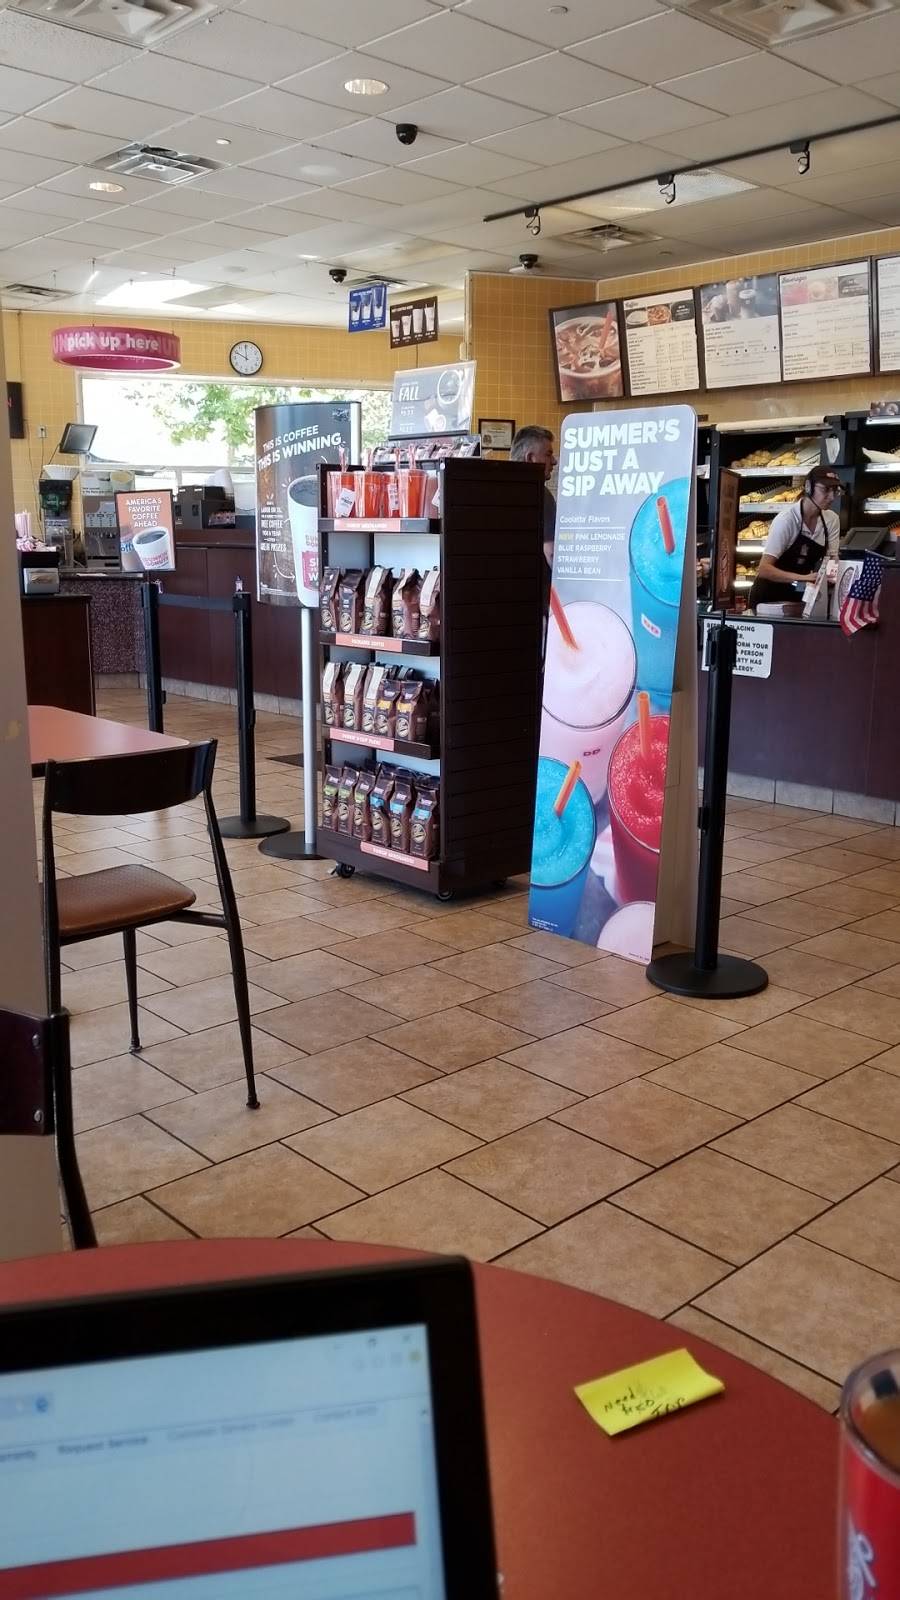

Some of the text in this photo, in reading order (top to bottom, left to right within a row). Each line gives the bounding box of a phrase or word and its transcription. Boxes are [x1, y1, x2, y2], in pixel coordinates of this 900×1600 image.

[67, 332, 96, 352] pick
[100, 336, 121, 351] up
[126, 333, 159, 351] here
[399, 386, 419, 401] FALL
[262, 425, 319, 453] THIS IS COFFEE
[563, 418, 681, 450] SUMMER'S
[258, 454, 272, 471] THIS
[272, 449, 281, 464] IS
[562, 447, 640, 473] JUST A
[561, 471, 665, 497] SIP AWAY
[128, 505, 161, 513] FAVORITE
[132, 513, 159, 521] COFFEE
[590, 533, 626, 541] LEMONADE
[558, 544, 612, 552] BLUE RASPBERRY
[557, 555, 600, 563] STRAWBERRY
[557, 566, 601, 575] VANILLA BEAN
[740, 649, 764, 657] PERSON
